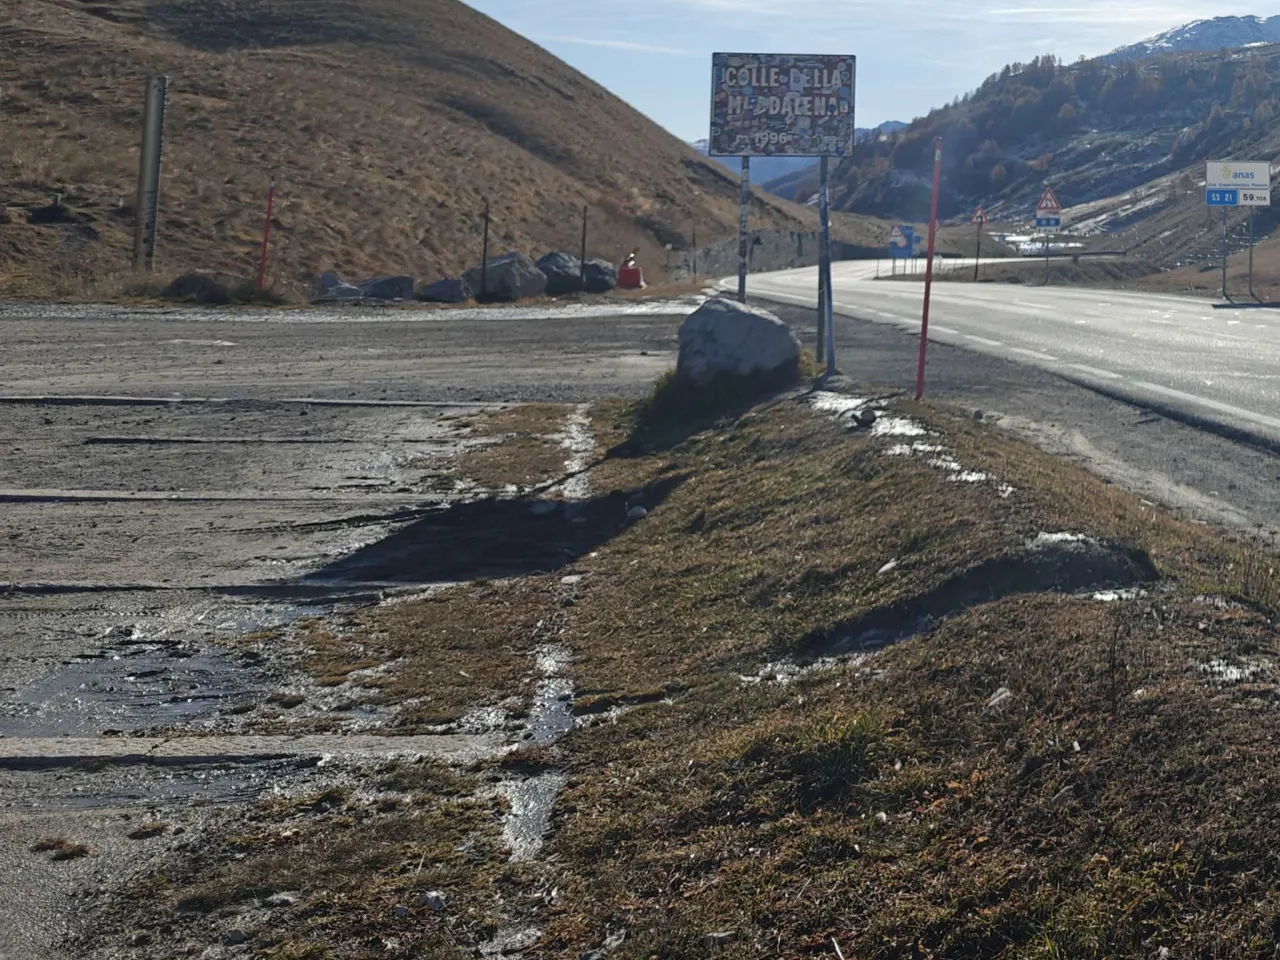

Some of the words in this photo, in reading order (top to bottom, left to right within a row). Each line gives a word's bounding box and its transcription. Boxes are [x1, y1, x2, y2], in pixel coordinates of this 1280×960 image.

[726, 67, 780, 87] COLLE
[790, 68, 842, 88] DELLA
[727, 95, 839, 115] MDDALENA
[754, 132, 787, 145] 1996
[1232, 171, 1255, 179] anas
[1211, 193, 1221, 202] SS
[1224, 193, 1232, 202] 21
